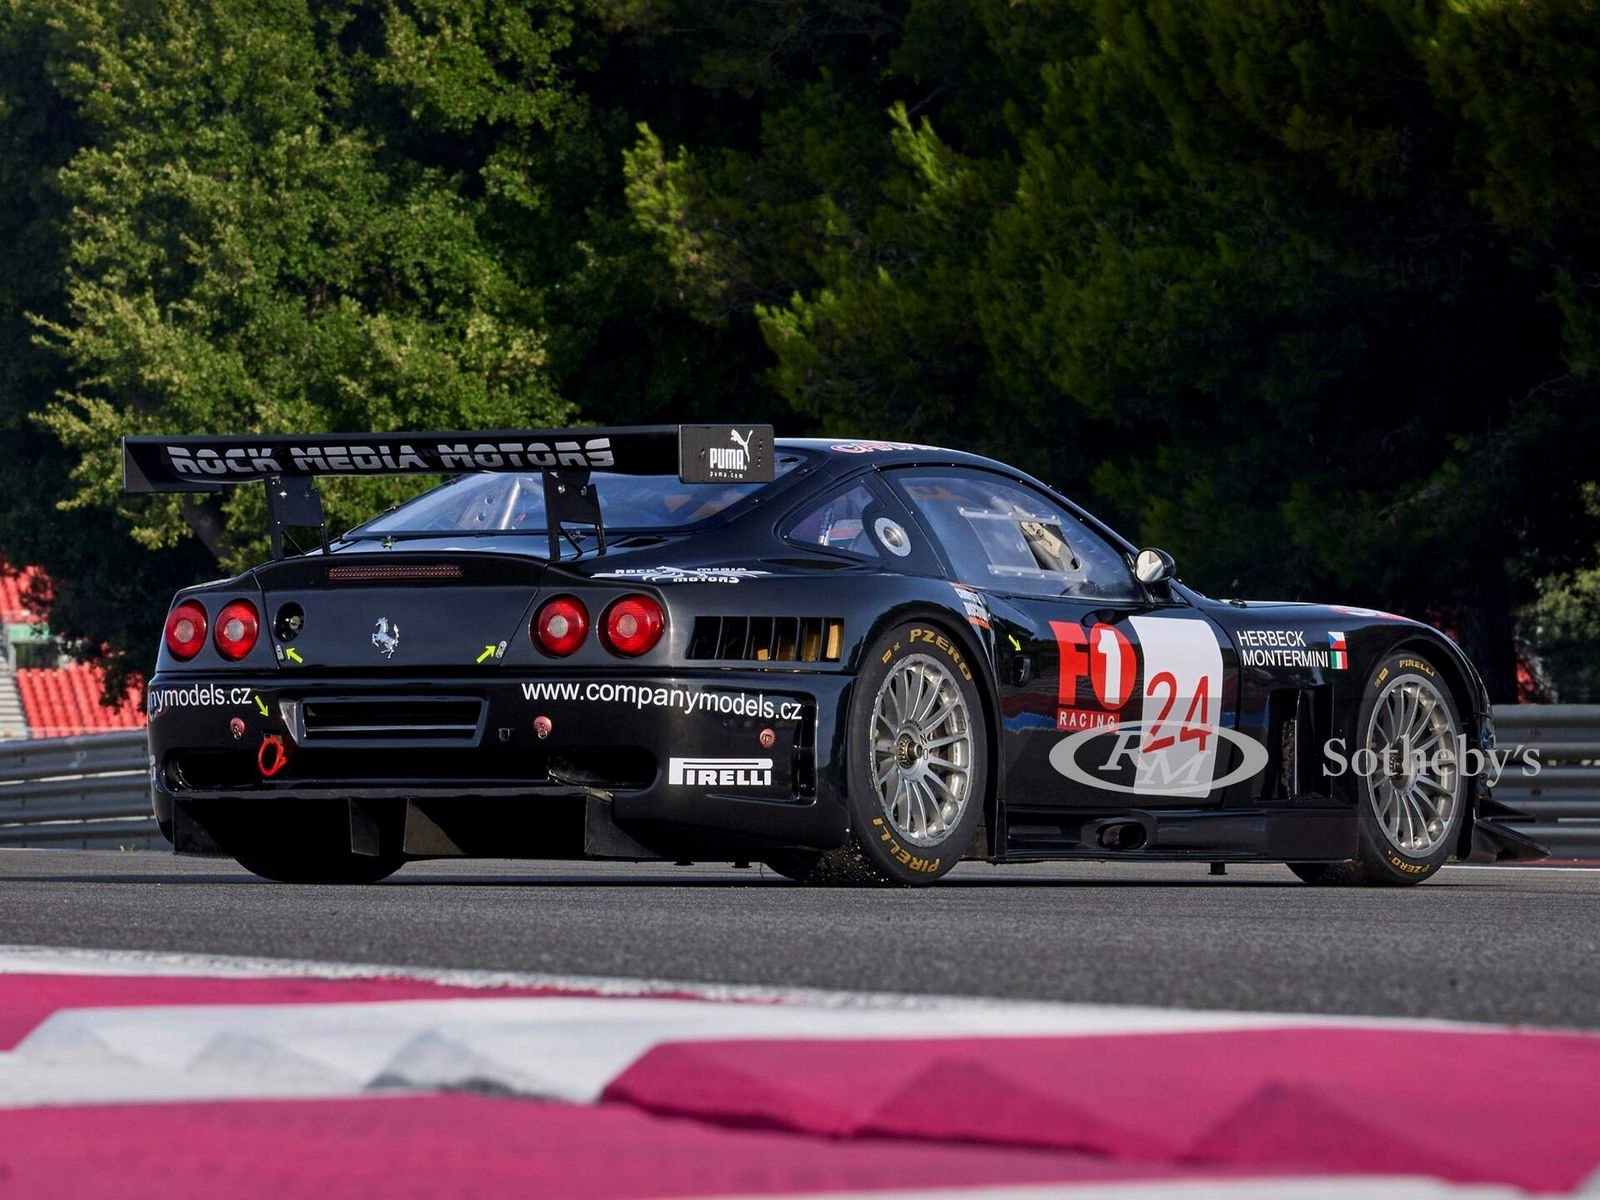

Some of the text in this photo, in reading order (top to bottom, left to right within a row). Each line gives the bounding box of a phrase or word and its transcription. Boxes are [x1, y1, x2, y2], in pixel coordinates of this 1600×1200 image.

[167, 438, 615, 474] ROCK MEDIA MOTORS
[709, 447, 744, 470] PUMA
[1236, 630, 1307, 648] HERBECK
[1241, 650, 1330, 668] MONTERMINI
[1399, 659, 1435, 677] PIRELLI
[521, 682, 803, 720] www.companymodels.cz
[1142, 671, 1213, 754] 24
[1059, 711, 1116, 731] RACING
[668, 757, 774, 786] PIRELLI
[871, 817, 942, 873] PIRELLI
